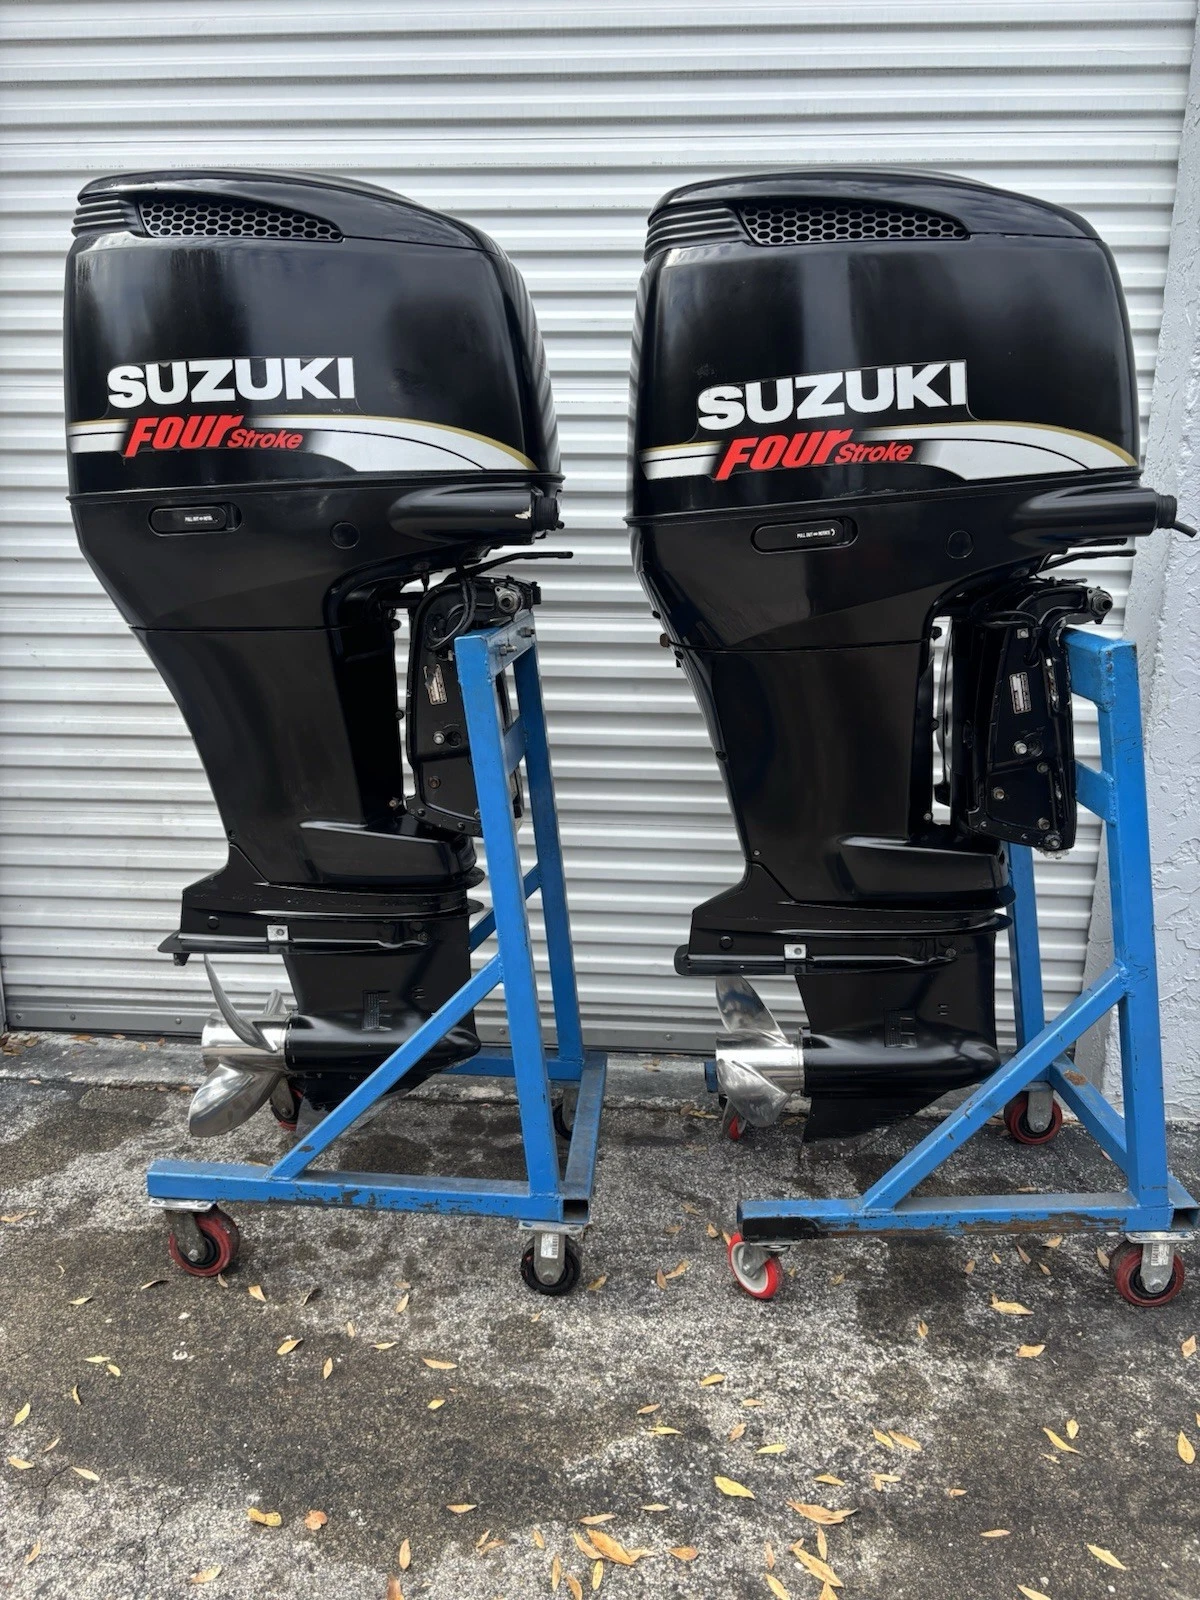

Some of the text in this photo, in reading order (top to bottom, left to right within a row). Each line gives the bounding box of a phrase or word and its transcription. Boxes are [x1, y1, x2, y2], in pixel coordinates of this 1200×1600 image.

[107, 357, 355, 409] SUZUKI
[698, 361, 967, 430] SUZUKI
[227, 428, 304, 449] Stroke
[835, 441, 914, 464] Stroke
